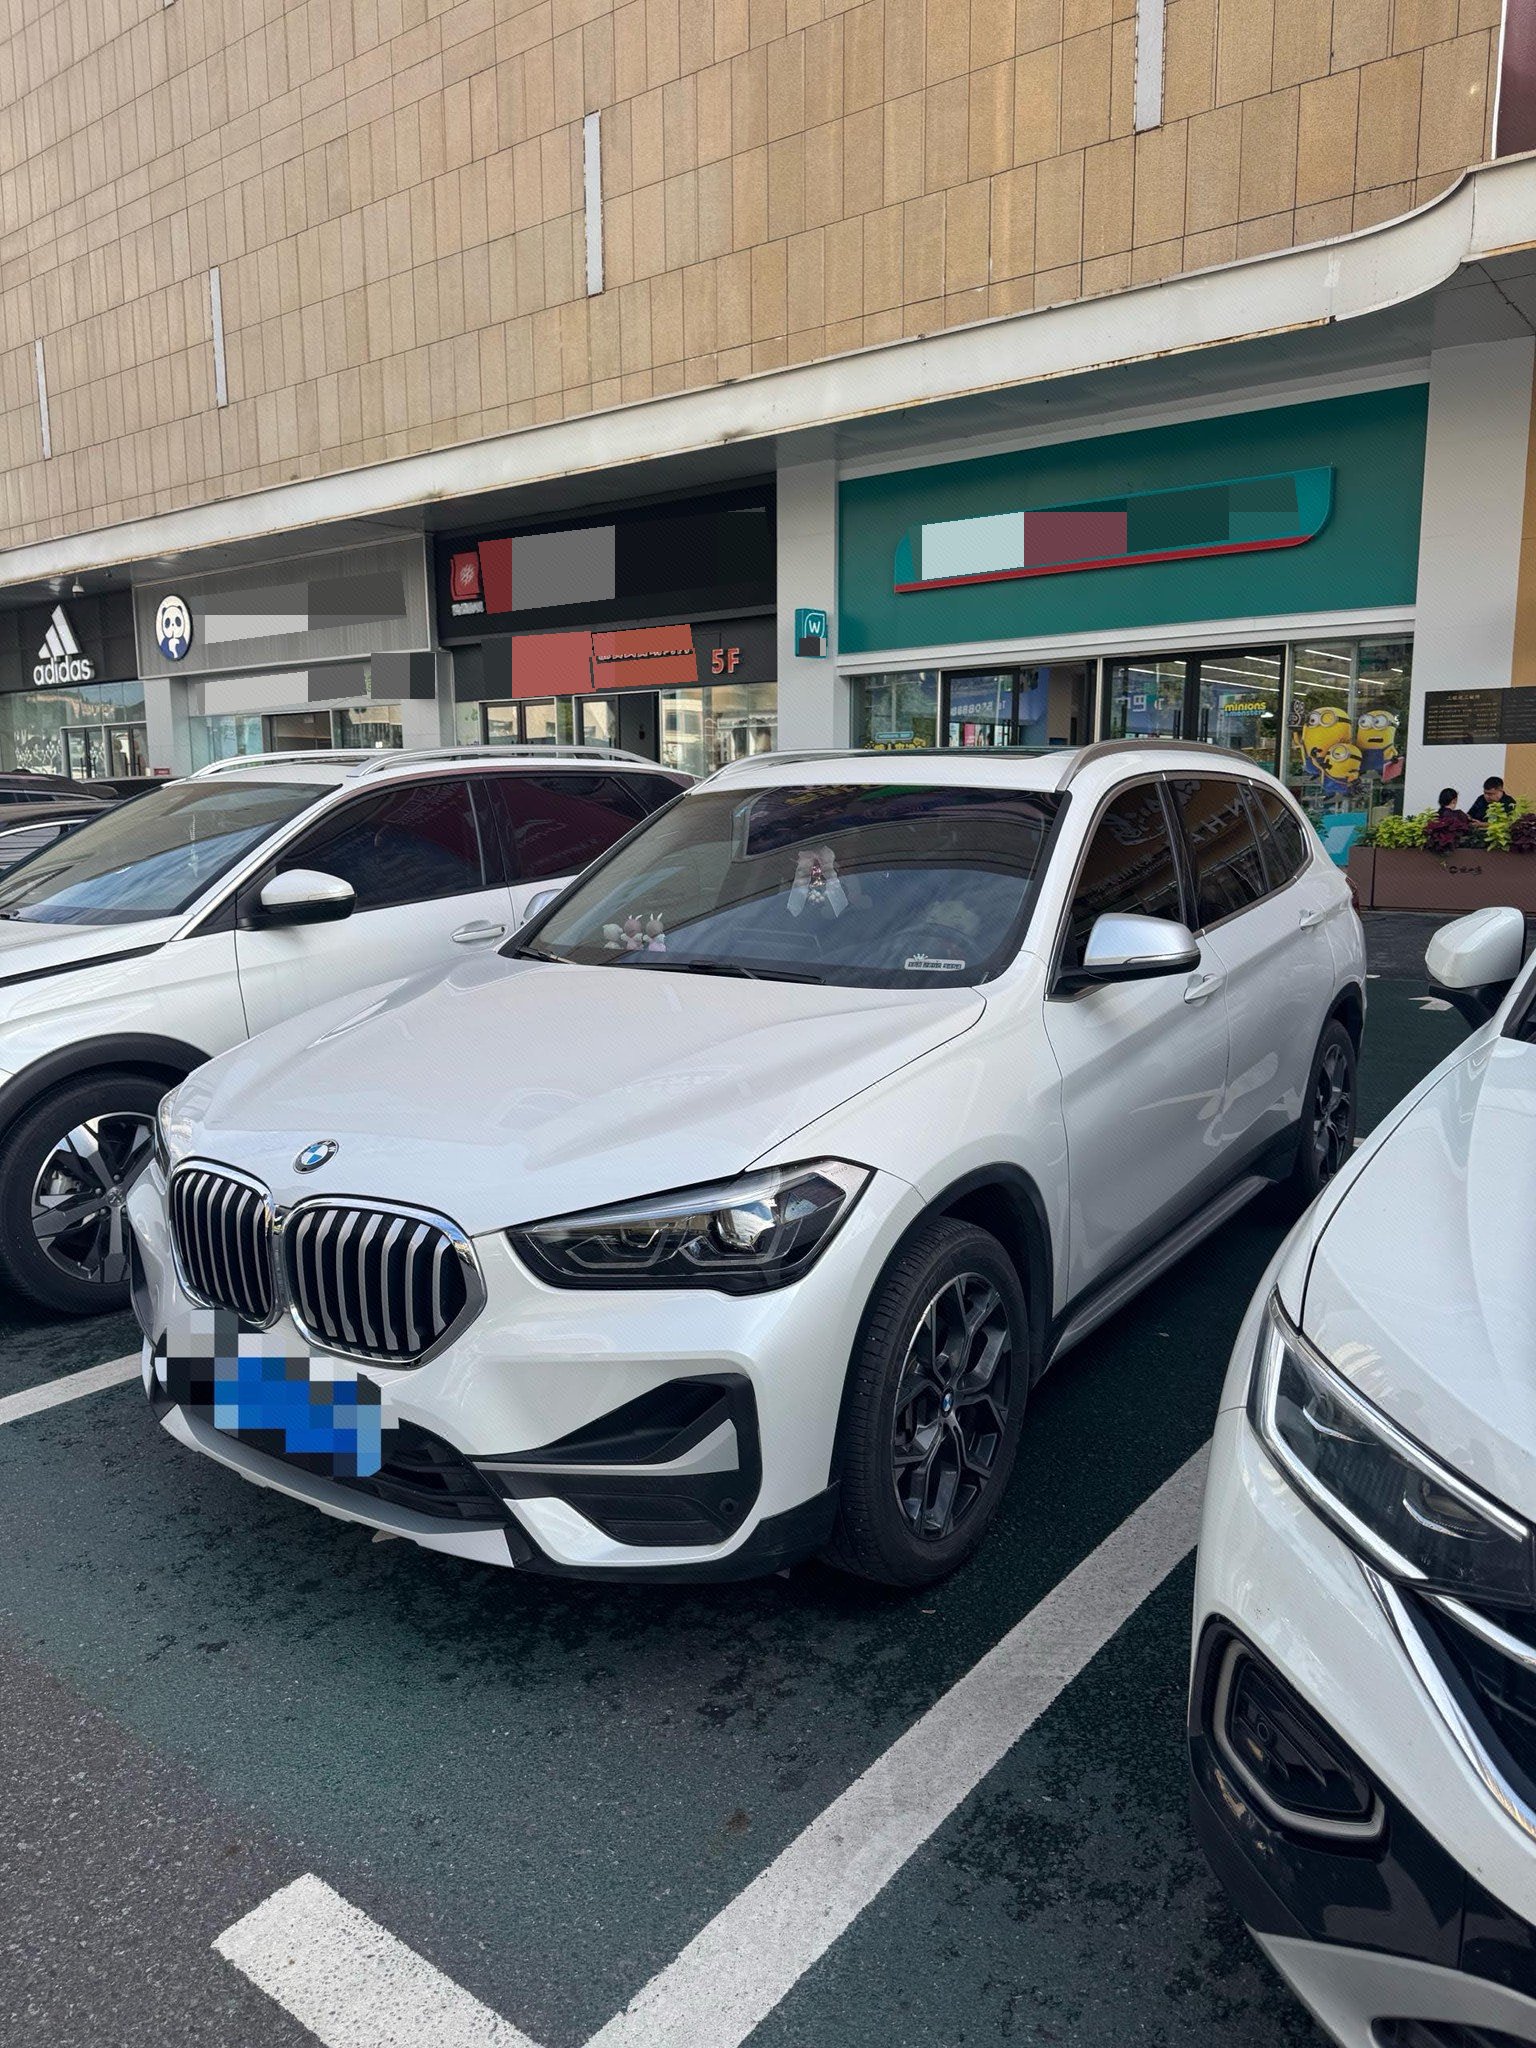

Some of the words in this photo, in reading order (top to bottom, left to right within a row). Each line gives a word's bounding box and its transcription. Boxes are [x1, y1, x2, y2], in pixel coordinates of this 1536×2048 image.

[808, 619, 821, 634] W
[33, 655, 92, 686] adidas
[711, 647, 740, 674] 5F
[1224, 701, 1267, 711] minions
